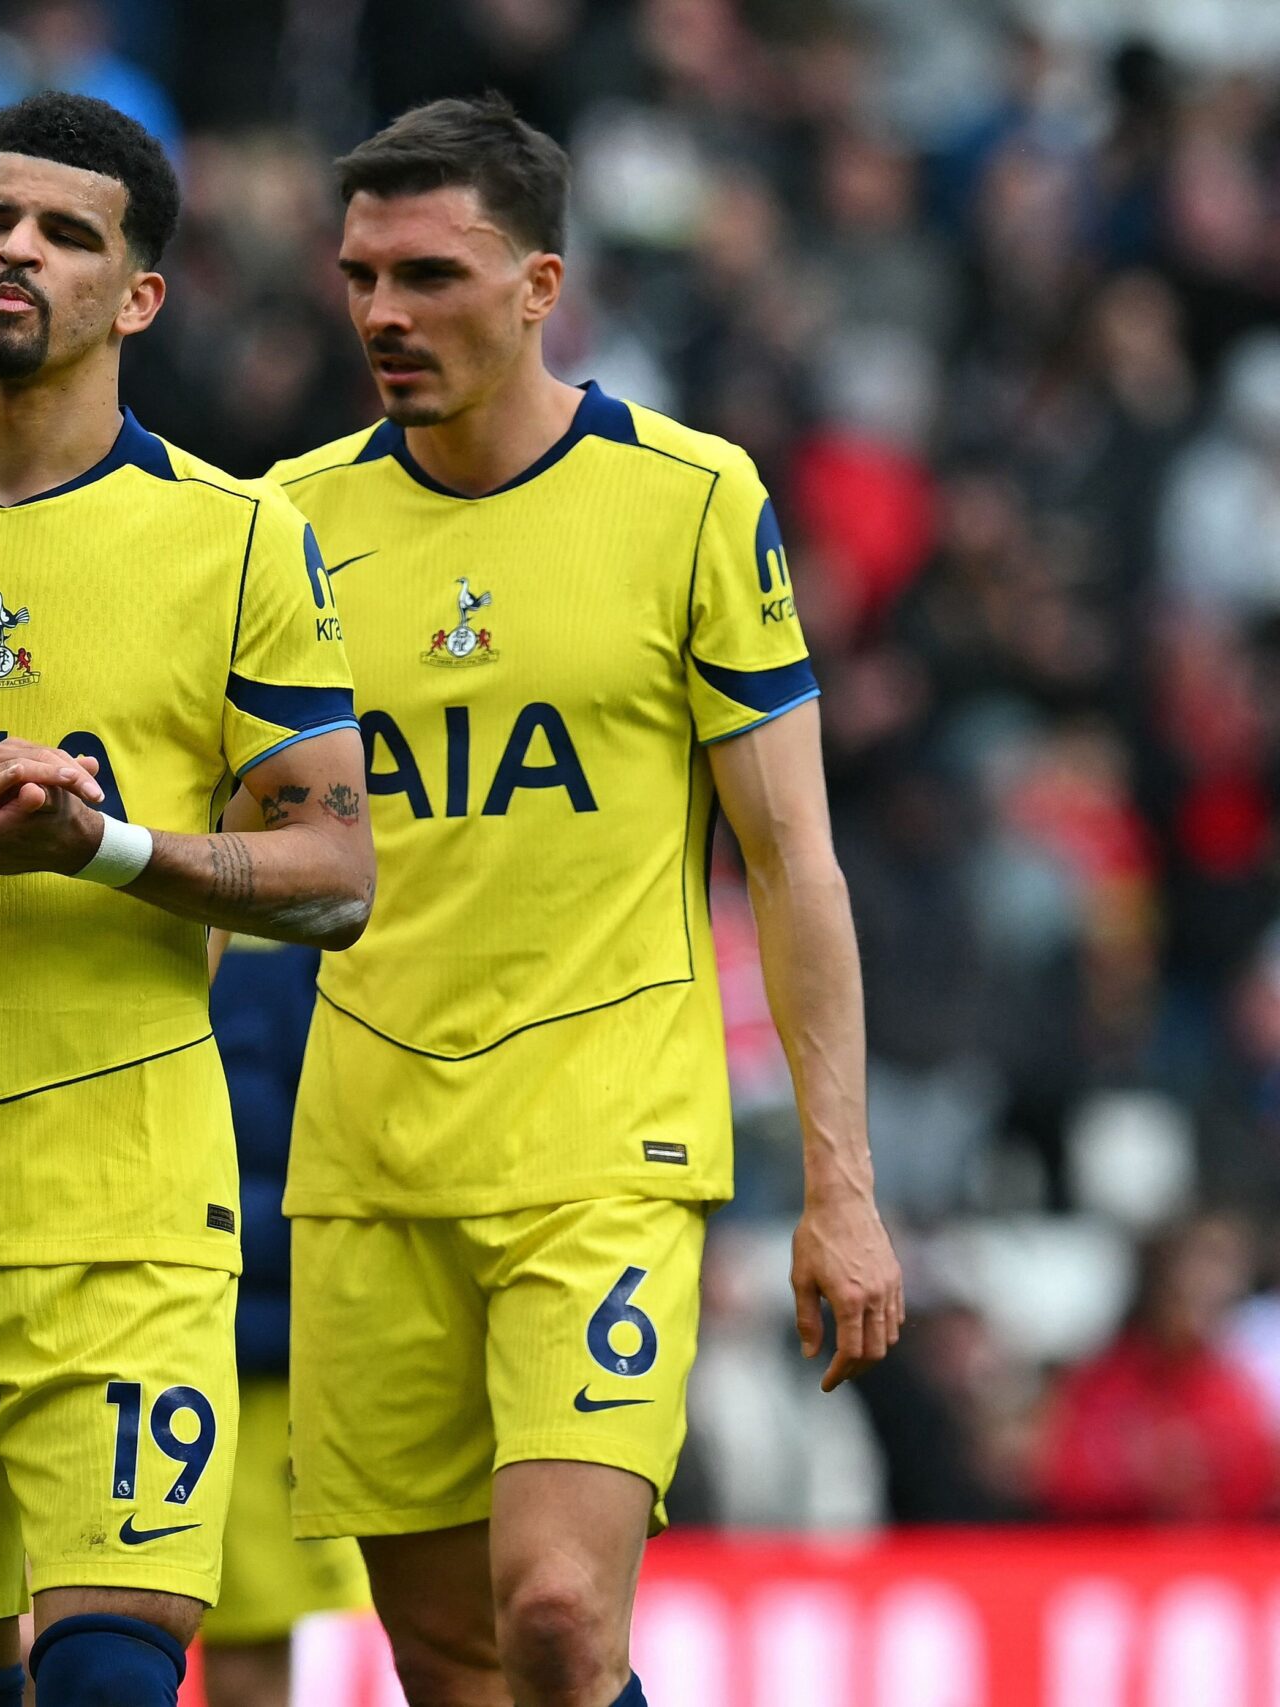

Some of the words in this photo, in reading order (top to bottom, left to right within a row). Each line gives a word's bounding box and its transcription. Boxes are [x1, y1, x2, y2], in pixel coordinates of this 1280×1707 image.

[358, 702, 599, 819] AIA
[586, 1265, 658, 1378] 6
[105, 1381, 217, 1505] 19
